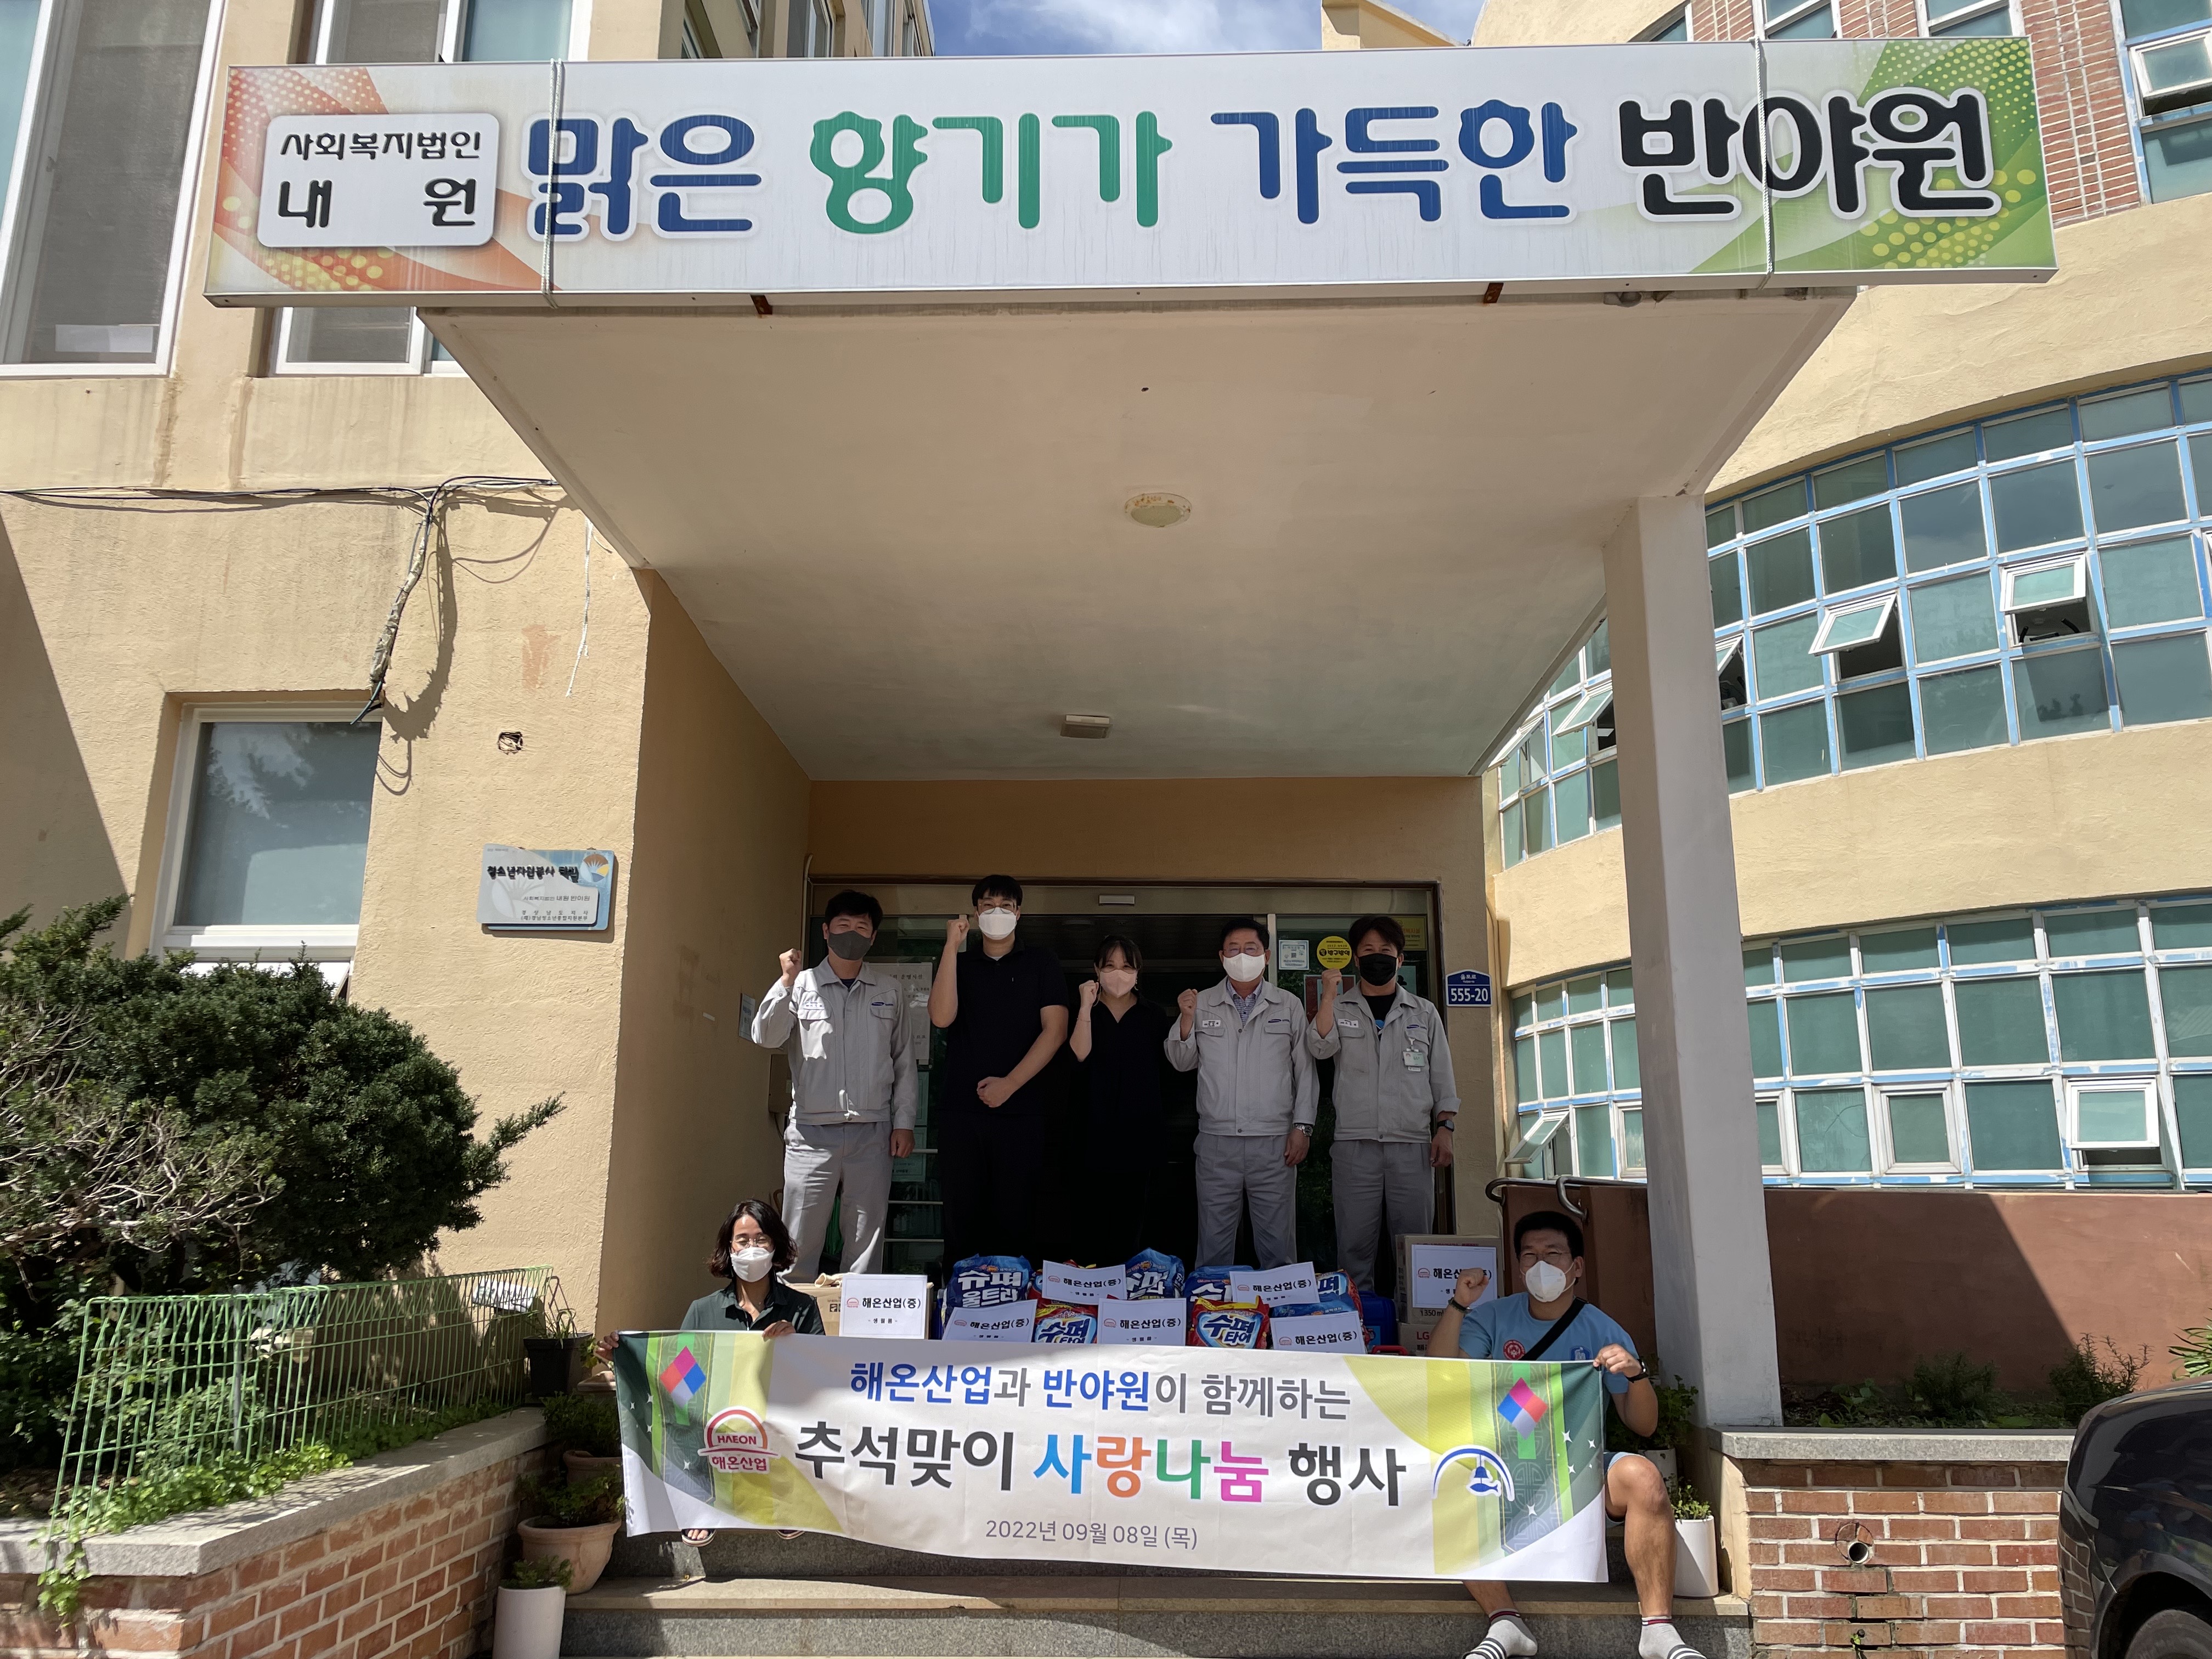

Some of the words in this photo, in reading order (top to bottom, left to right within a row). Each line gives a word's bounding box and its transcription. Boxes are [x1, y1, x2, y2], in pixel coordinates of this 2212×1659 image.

[280, 131, 481, 160] 사회복지법인
[528, 115, 761, 235] 맑은
[810, 110, 1172, 234] 향기가
[1210, 99, 1578, 224] 가득한
[1618, 93, 1995, 215] 반야원
[278, 179, 332, 228] 내
[423, 177, 476, 227] 원
[1451, 988, 1488, 1001] 555-20
[958, 1270, 1022, 1290] 슈퍼
[862, 1297, 921, 1309] 해온산업(증)
[962, 1288, 1018, 1308] 울트라
[1417, 1331, 1430, 1340] LG
[851, 1362, 1031, 1408] 해온산업과
[1044, 1368, 1187, 1414] 반야원이
[1201, 1374, 1351, 1420] 함께하는
[718, 1435, 757, 1444] HAEON
[712, 1457, 766, 1471] 해온산업
[795, 1421, 1014, 1492] 추석맞이
[1034, 1432, 1269, 1503] 사랑나눔
[1289, 1442, 1407, 1507] 행사
[986, 1520, 1056, 1543] 2022년
[1063, 1522, 1108, 1545] 09월
[1113, 1525, 1158, 1548] 08일
[1165, 1526, 1198, 1551] (목)
